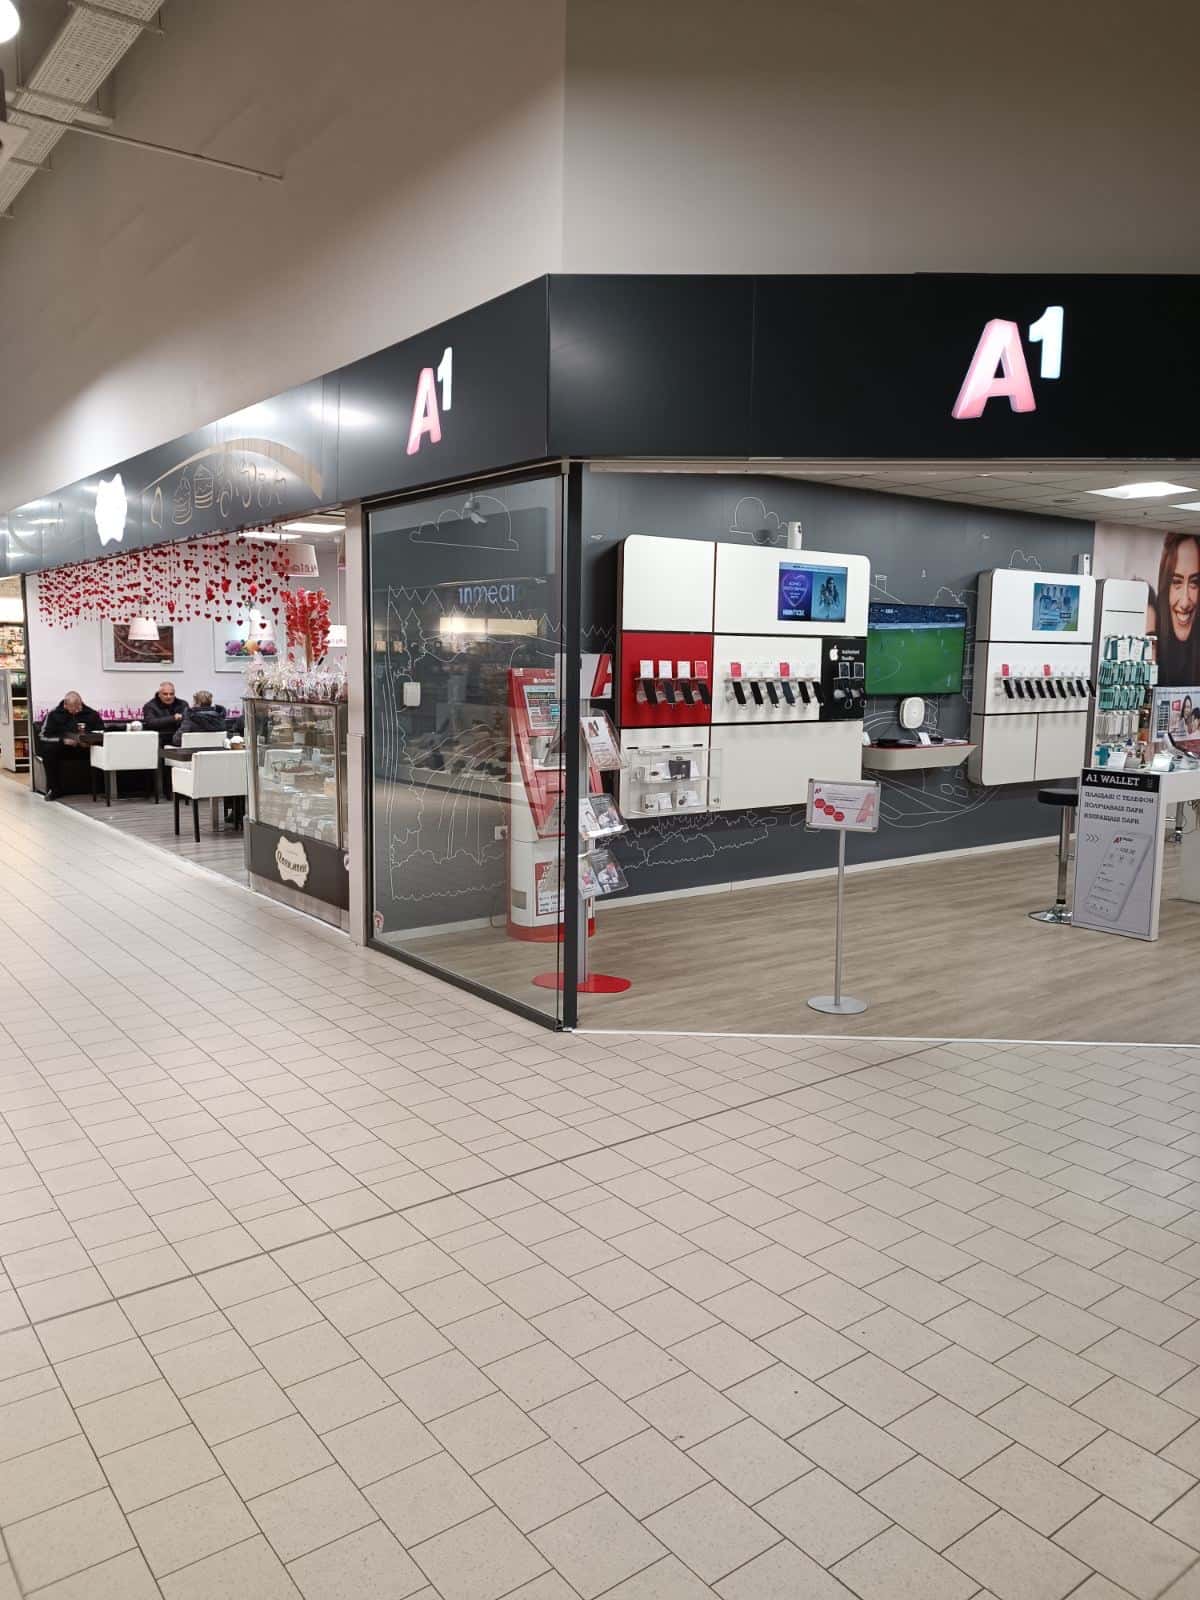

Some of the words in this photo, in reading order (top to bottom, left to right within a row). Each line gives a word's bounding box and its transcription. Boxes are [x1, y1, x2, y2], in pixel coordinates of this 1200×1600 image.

[406, 346, 453, 456] A1
[951, 305, 1064, 420] A1
[1085, 773, 1099, 783] A1
[1100, 774, 1141, 786] WALLET
